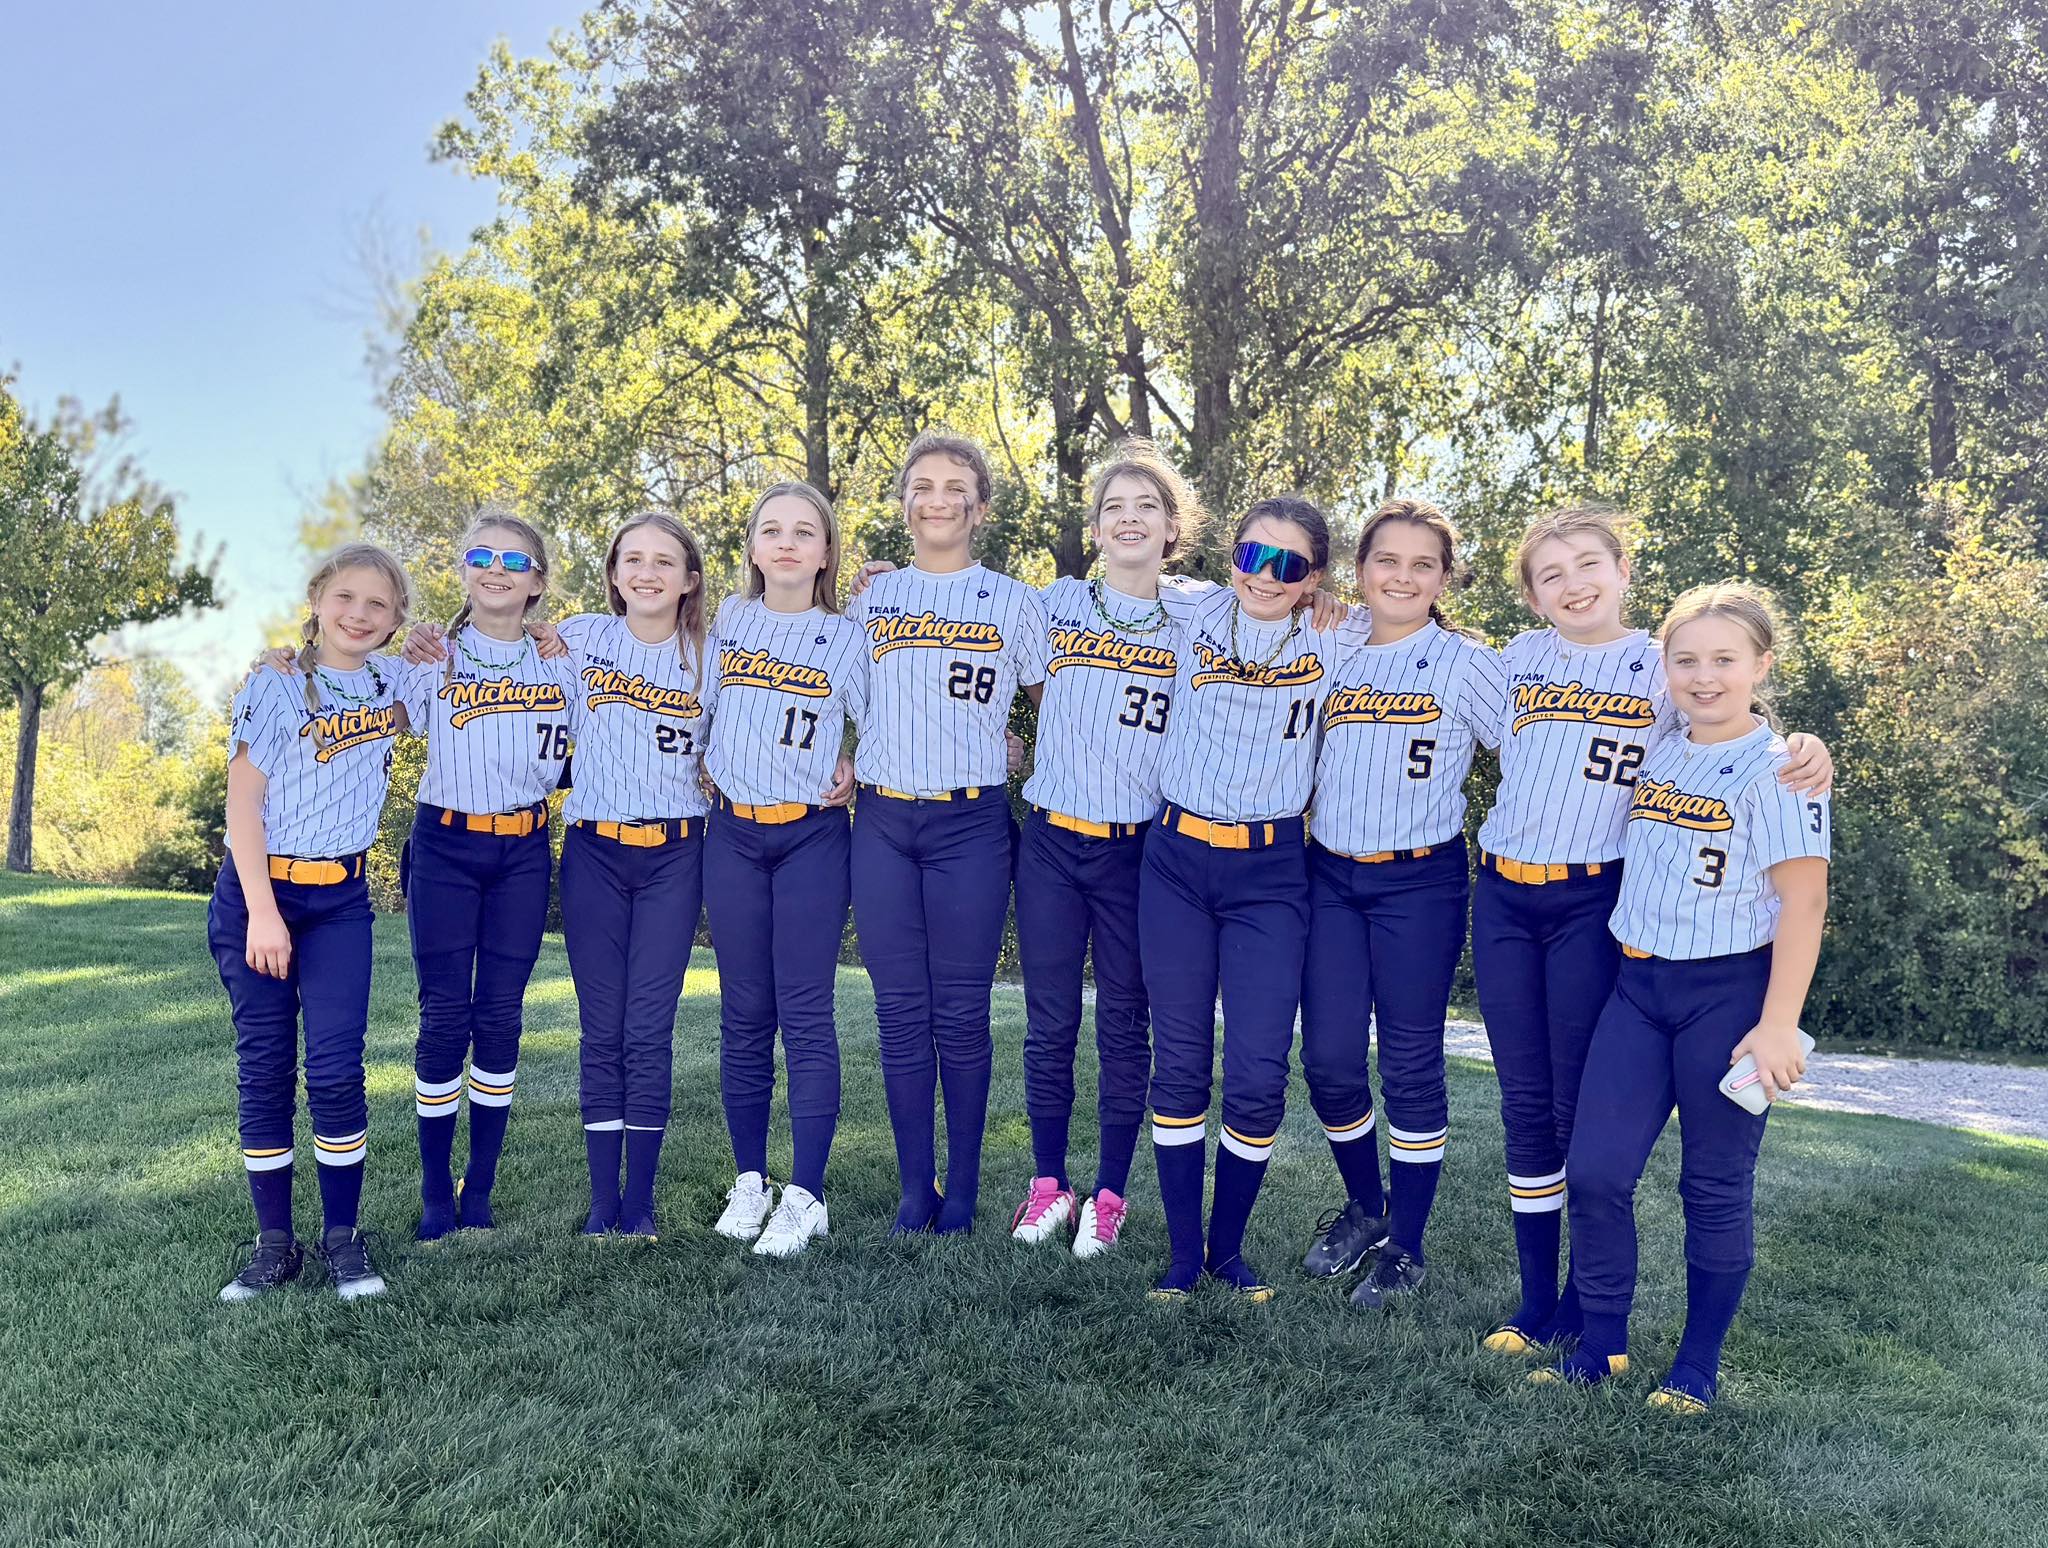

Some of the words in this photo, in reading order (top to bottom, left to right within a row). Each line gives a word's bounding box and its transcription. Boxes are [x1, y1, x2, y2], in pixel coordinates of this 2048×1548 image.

[866, 610, 1000, 646] Michigan
[868, 606, 900, 614] TEAM
[1051, 614, 1081, 628] TEAM
[586, 653, 614, 668] TEAM
[877, 641, 914, 653] FASTPITCH
[1047, 627, 1177, 668] Michigan
[438, 676, 563, 709] Michigan
[948, 661, 996, 704] 28
[1510, 680, 1655, 719] Michigan
[299, 704, 394, 742] Michiga
[460, 706, 499, 720] FASTPITCH
[779, 706, 819, 750] 17
[1118, 685, 1170, 735] 33
[1283, 699, 1314, 739] 11
[1517, 713, 1554, 725] FASTPITCH
[536, 723, 568, 761] 76
[656, 724, 694, 755] 27
[1407, 739, 1436, 780] 5
[1584, 736, 1645, 787] 52
[1632, 778, 1729, 821] ichigan
[1807, 802, 1823, 834] 3
[1693, 847, 1726, 888] 3
